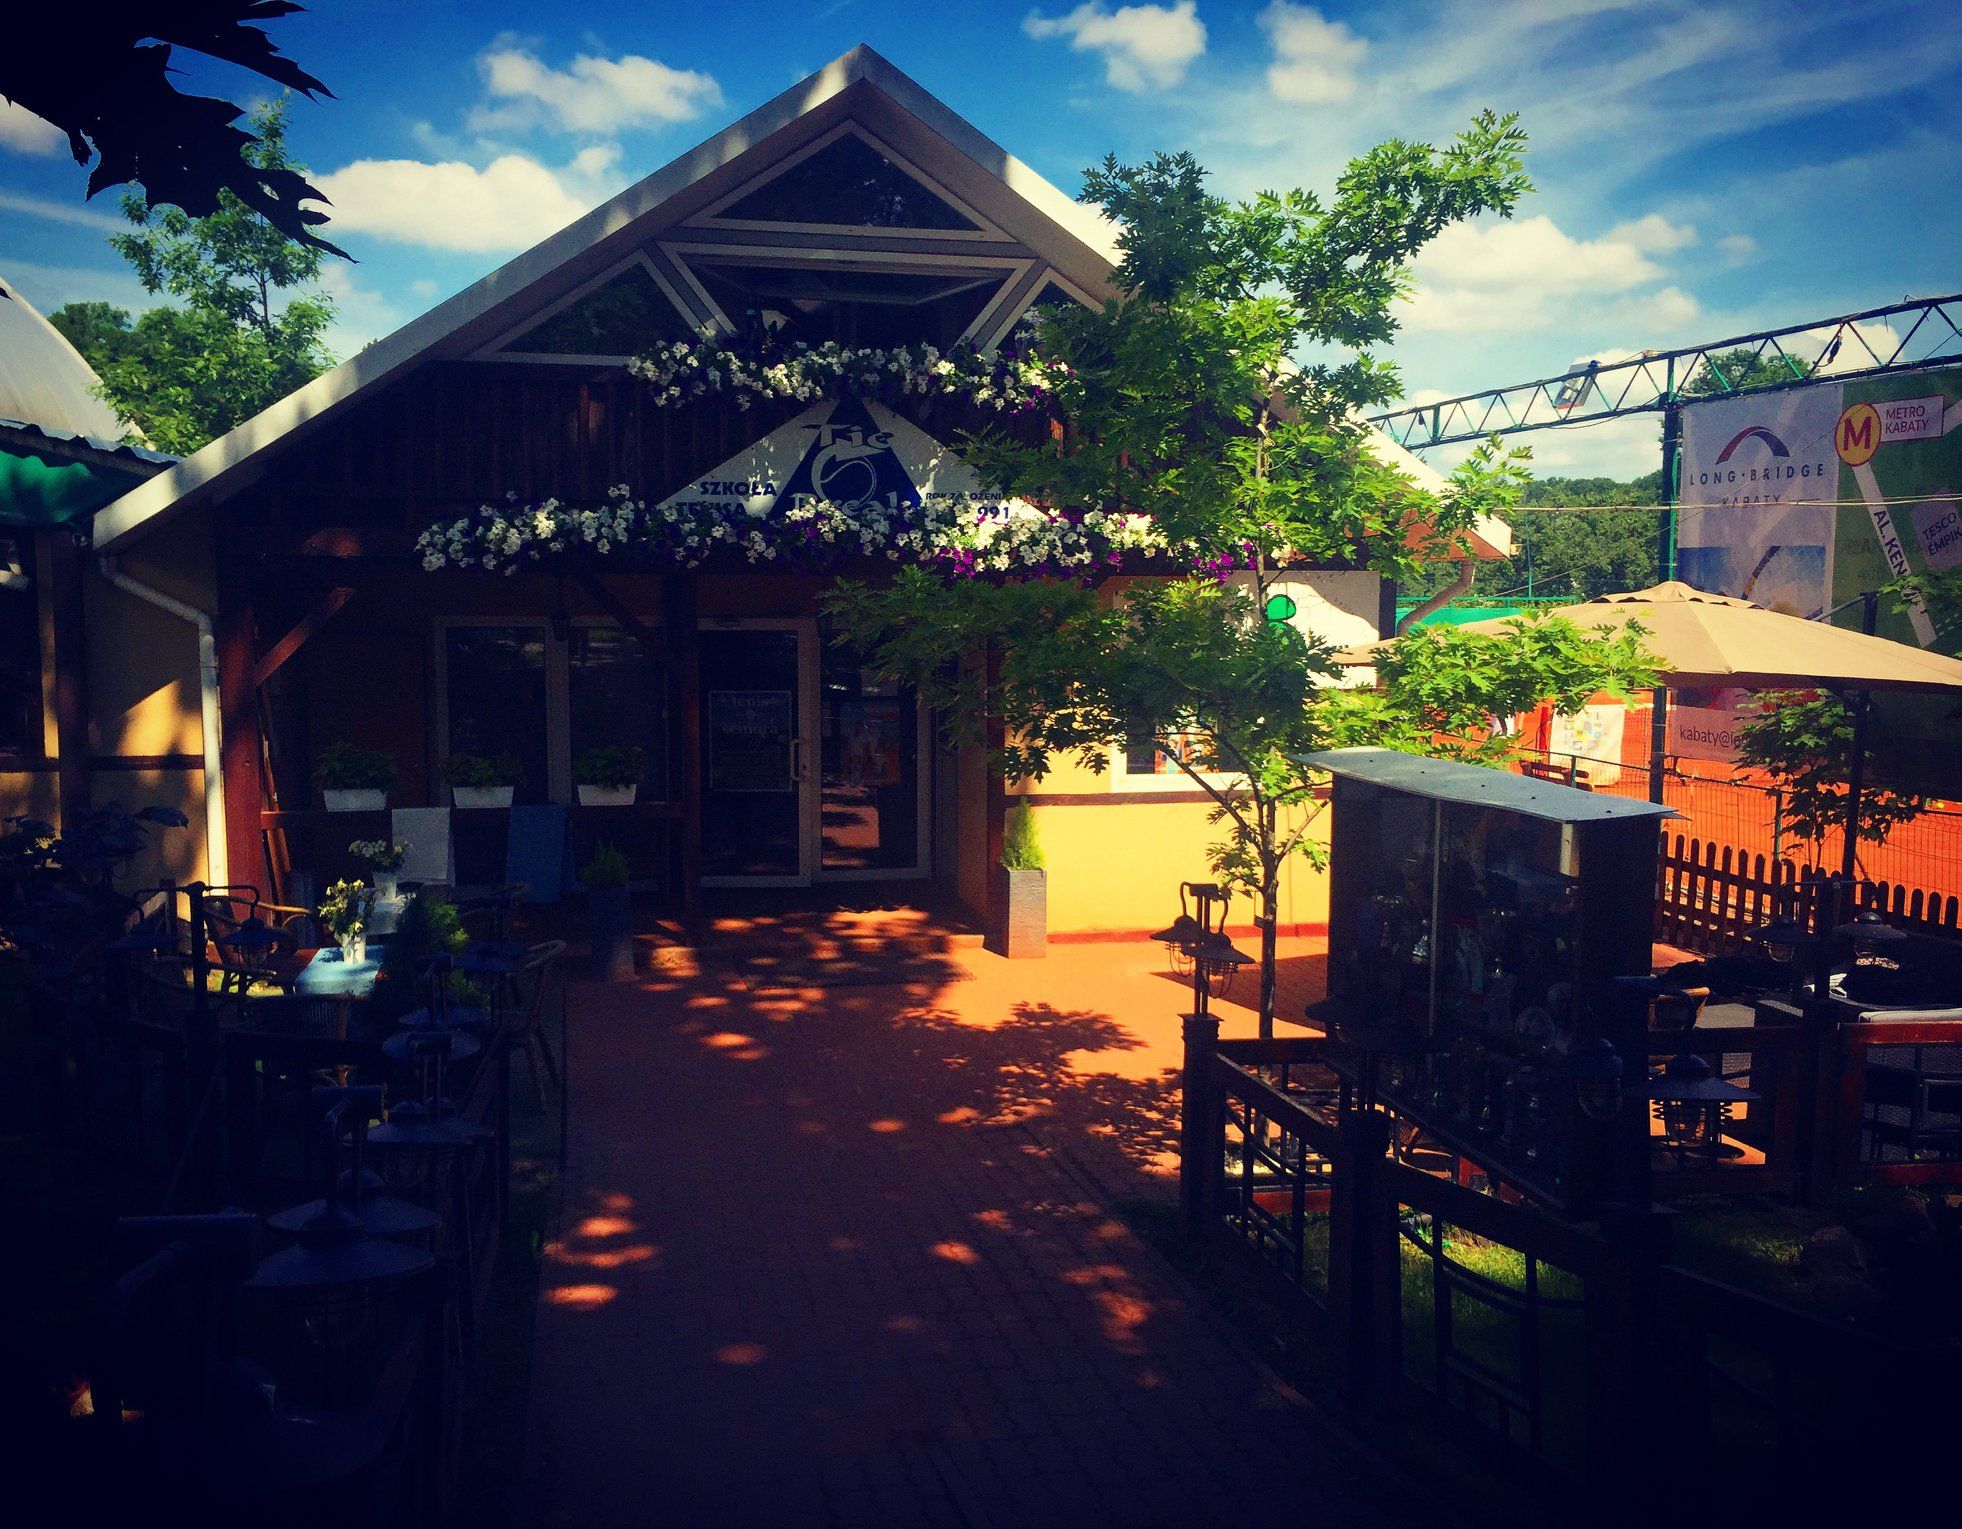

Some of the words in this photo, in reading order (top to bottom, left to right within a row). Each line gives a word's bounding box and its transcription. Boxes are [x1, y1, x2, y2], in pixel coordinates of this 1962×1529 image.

[1885, 405, 1926, 420] METRO
[1885, 419, 1930, 434] KABATY
[1843, 416, 1873, 451] M
[700, 481, 778, 497] SZKOŁA
[1922, 512, 1957, 540] TESCO
[1873, 510, 1890, 539] AL.
[1884, 537, 1908, 578] KEN
[1927, 526, 1962, 556] EMPIK
